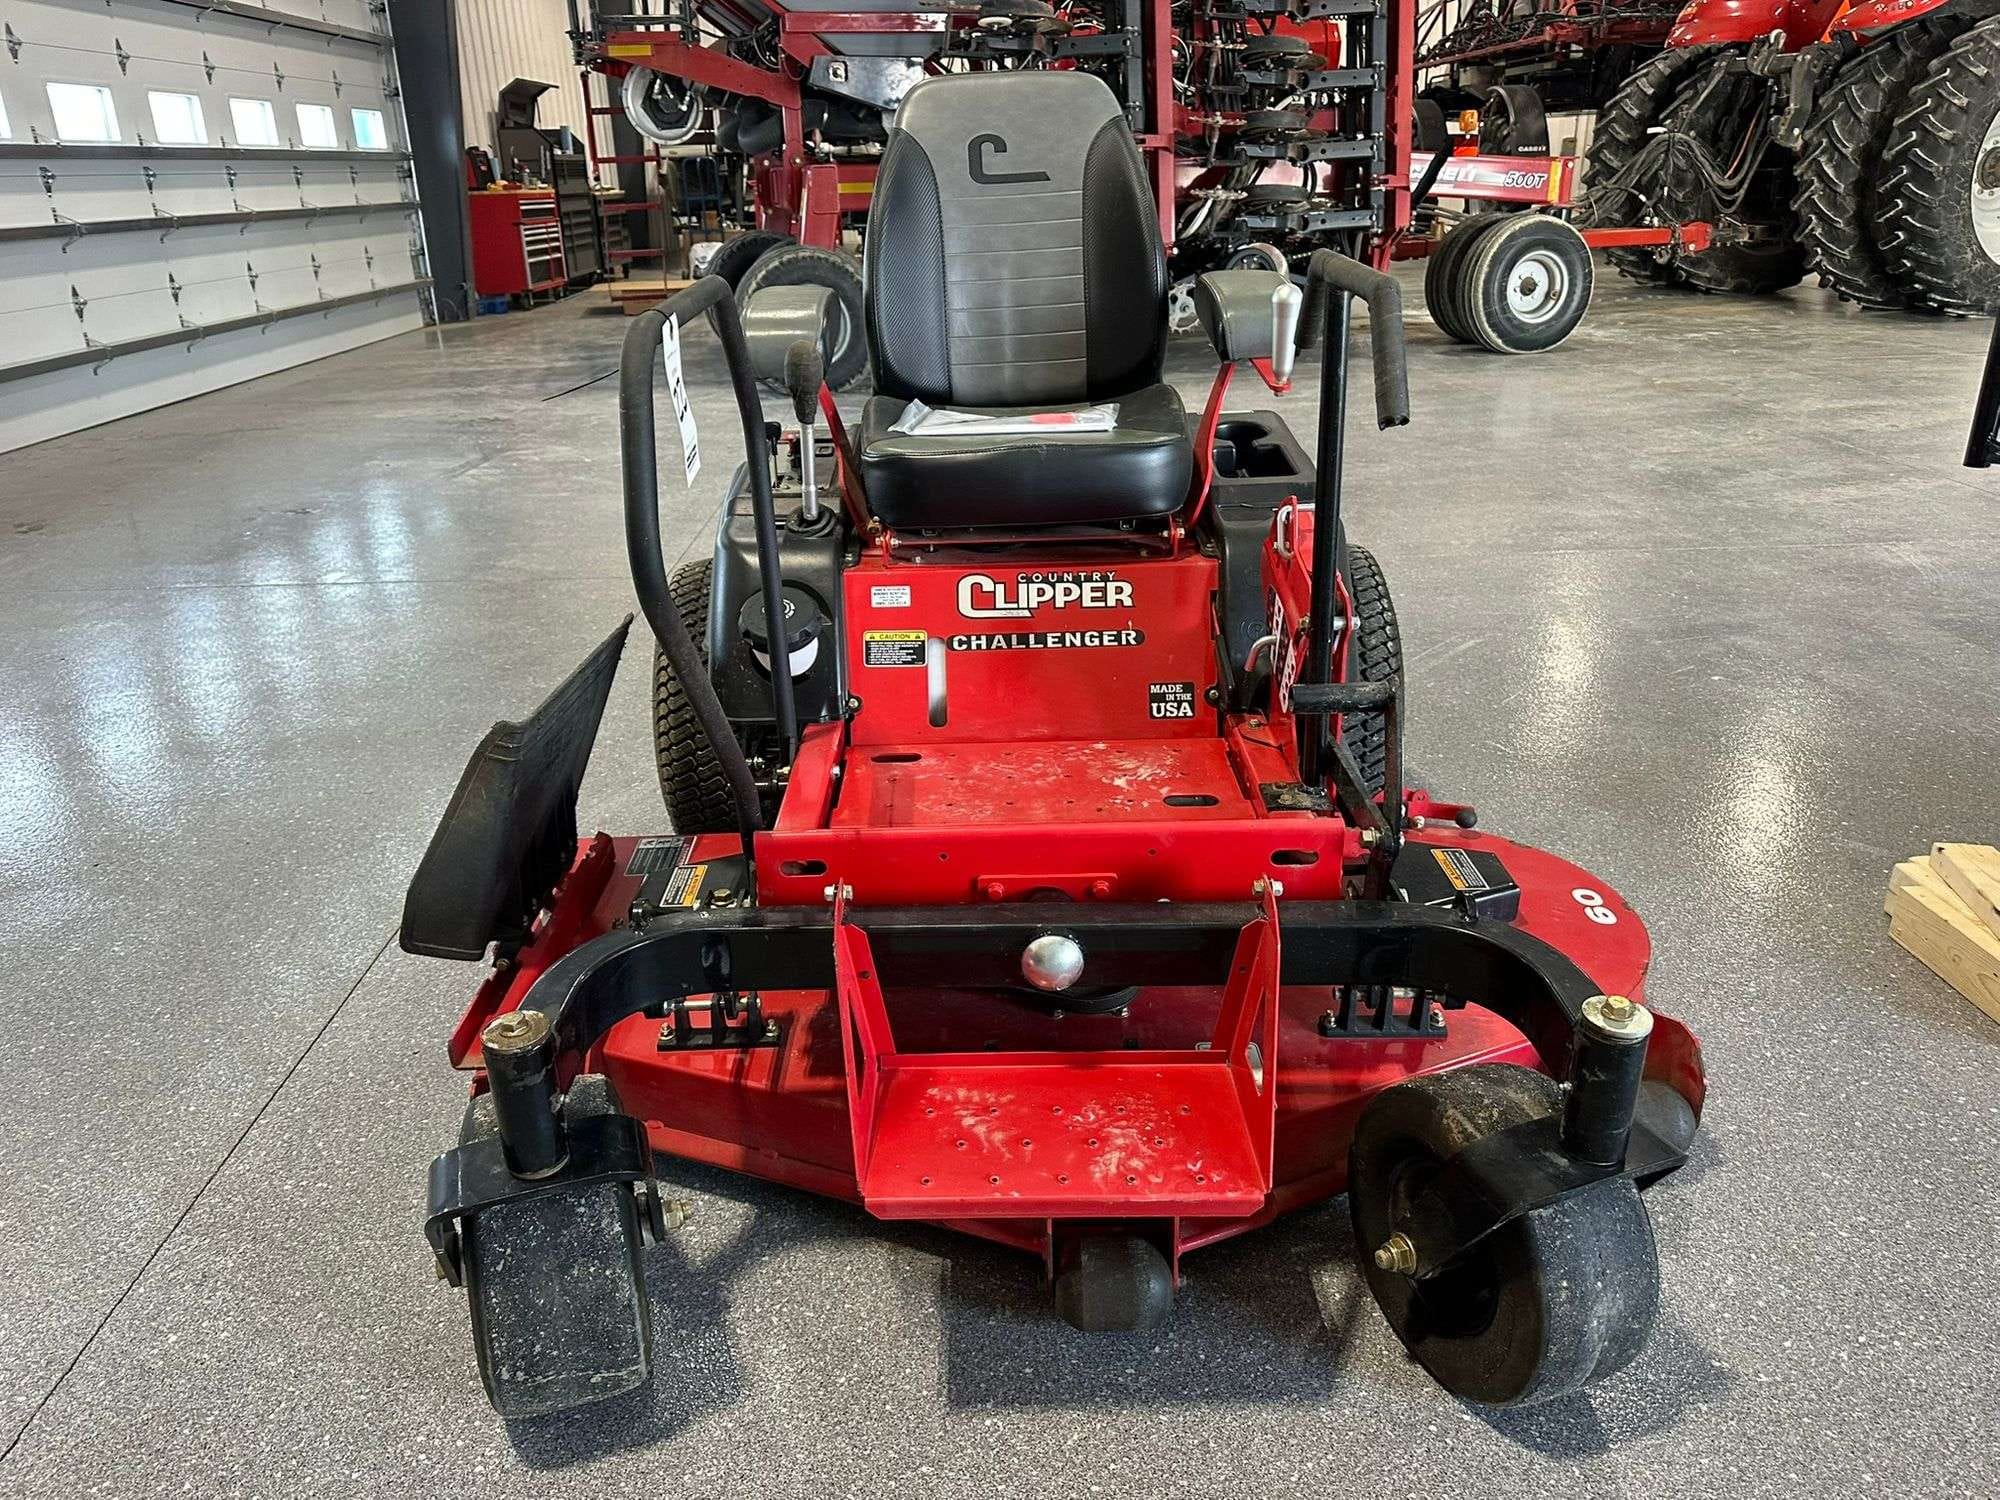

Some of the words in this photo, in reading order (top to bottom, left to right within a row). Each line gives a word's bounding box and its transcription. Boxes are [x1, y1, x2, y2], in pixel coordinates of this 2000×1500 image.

[1504, 170, 1547, 188] 500T
[1017, 572, 1116, 583] COUNTRY
[957, 574, 1134, 618] CLIPPER
[952, 630, 1138, 651] CHALLENGER
[1150, 684, 1183, 694] MADE
[1165, 693, 1175, 701] IN
[1175, 693, 1193, 701] THE
[1151, 702, 1194, 717] USA
[1571, 887, 1618, 925] 60
